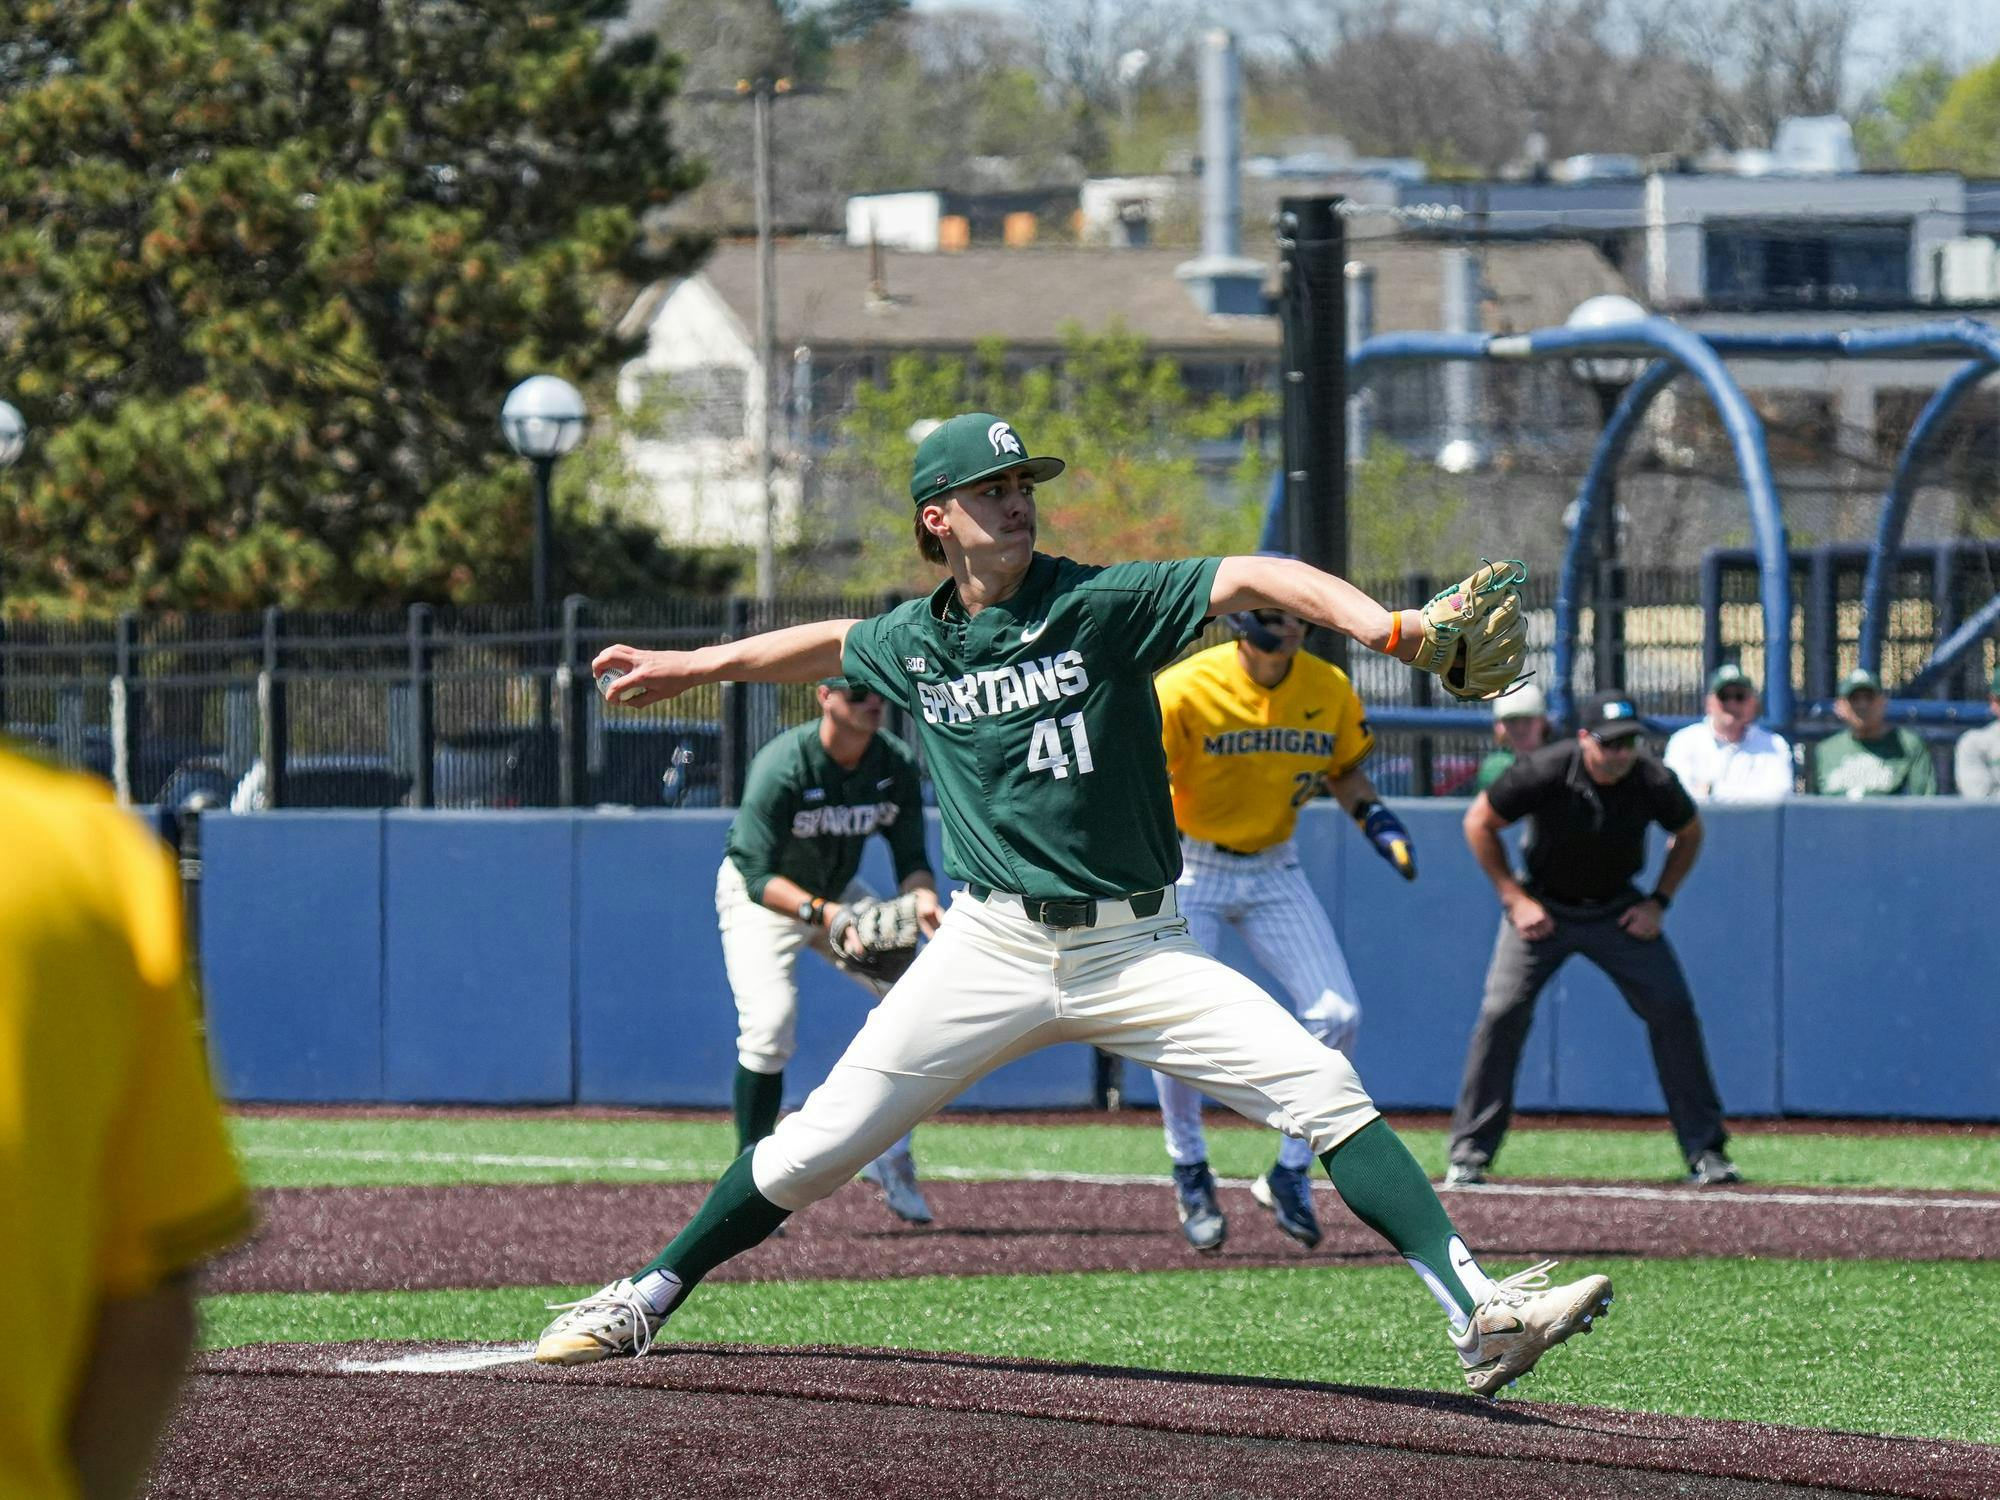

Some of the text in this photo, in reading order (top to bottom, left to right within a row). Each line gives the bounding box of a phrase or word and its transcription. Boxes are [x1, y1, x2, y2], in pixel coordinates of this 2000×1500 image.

[917, 650, 1089, 724] SPARTANS
[1027, 711, 1094, 780] 41
[1203, 726, 1336, 758] MICHIGAN
